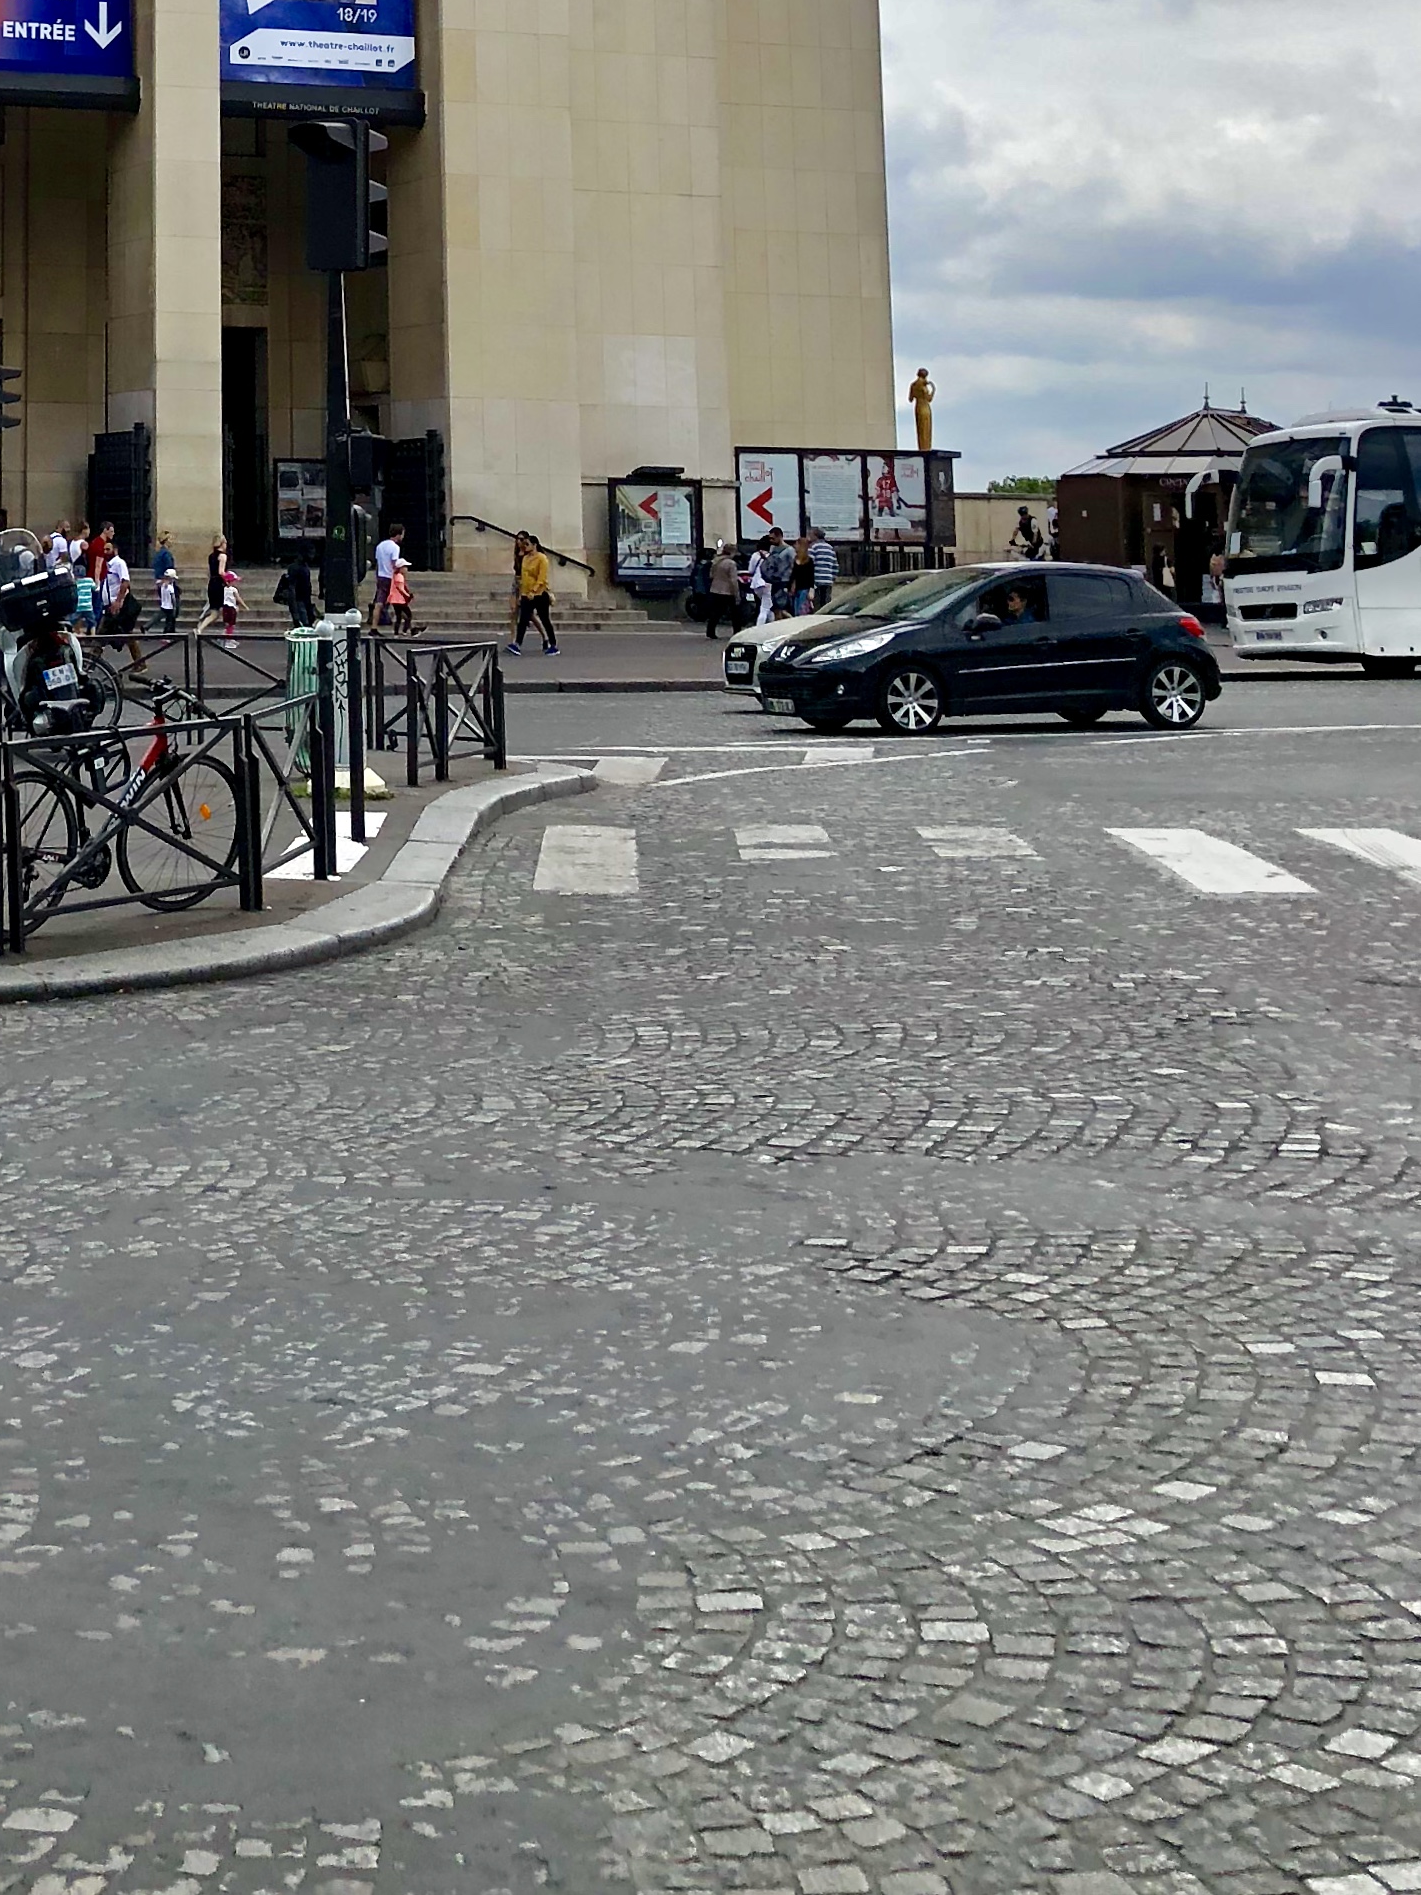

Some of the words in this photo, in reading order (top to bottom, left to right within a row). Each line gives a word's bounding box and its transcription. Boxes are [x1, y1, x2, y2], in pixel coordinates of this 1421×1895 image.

[336, 7, 378, 24] 18/19
[2, 18, 76, 42] ENTRÉE
[280, 40, 395, 55] www.theatre-chaillot.fr
[289, 104, 327, 113] NATIONAL
[342, 106, 380, 115] CHAILLOT
